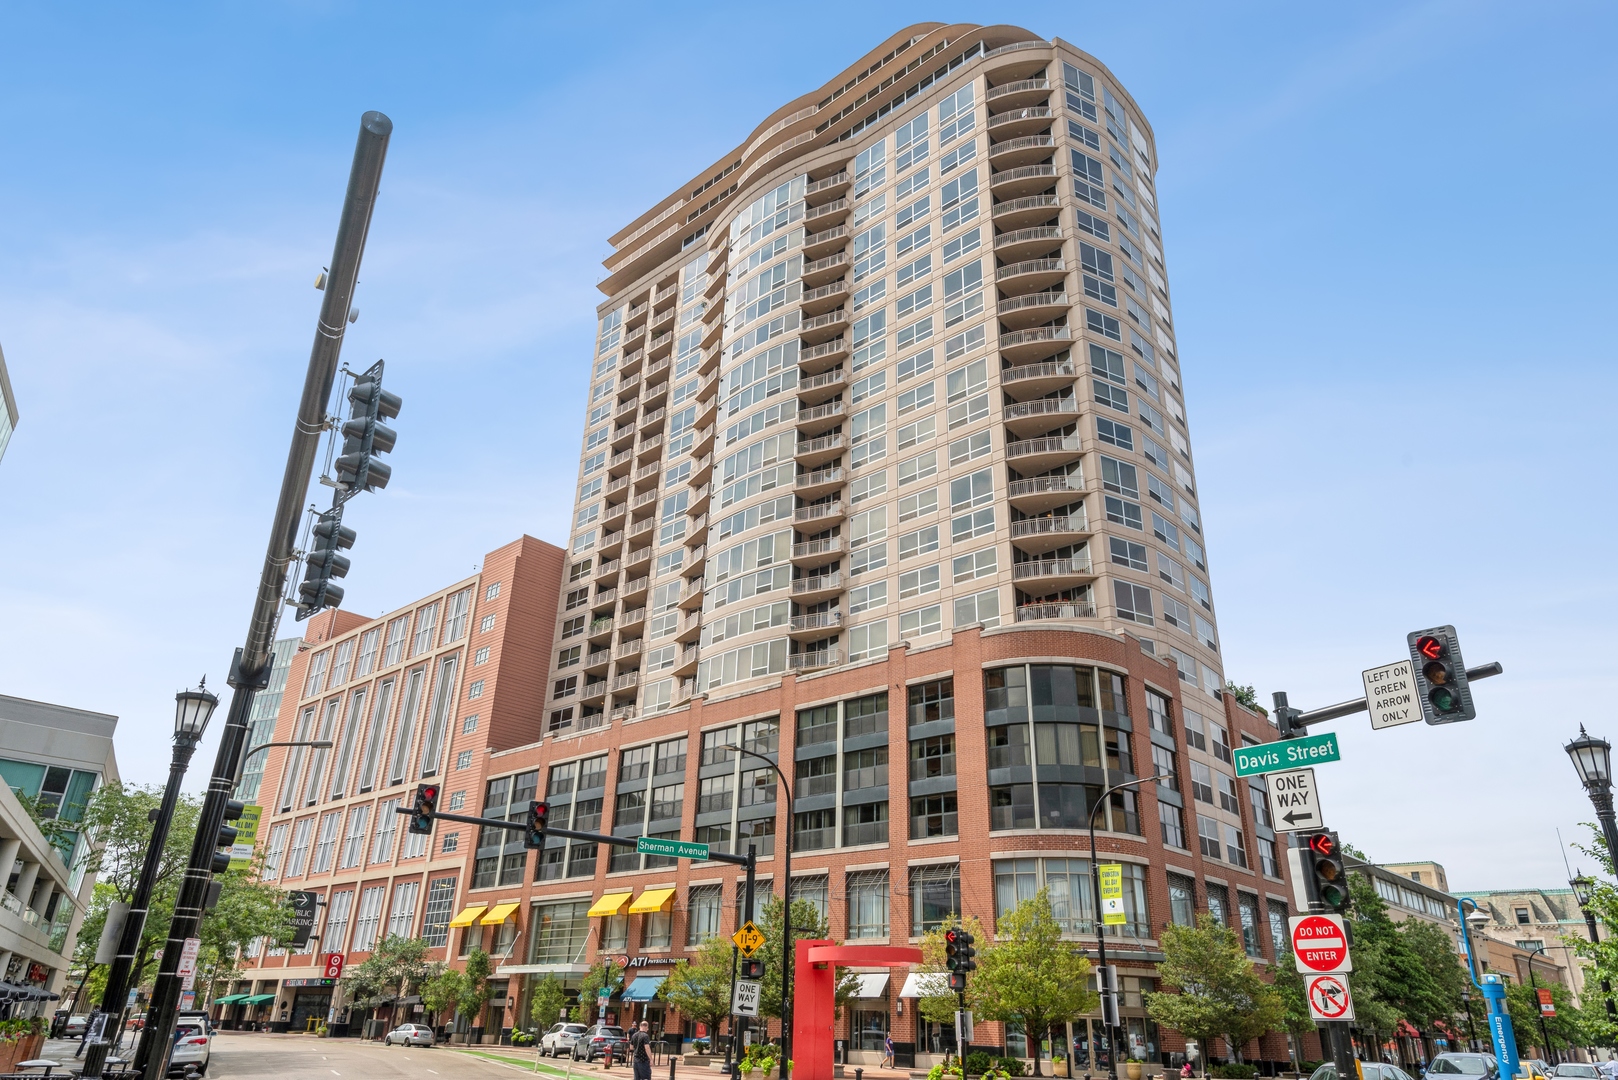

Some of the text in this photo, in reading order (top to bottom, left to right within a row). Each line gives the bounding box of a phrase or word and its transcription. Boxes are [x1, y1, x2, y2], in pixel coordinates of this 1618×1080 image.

[1367, 666, 1408, 683] LEFT ON
[1374, 681, 1407, 695] GREEN
[1376, 694, 1411, 710] ARROW
[1382, 708, 1409, 722] ONLY
[1239, 740, 1335, 769] Davis Street
[1275, 775, 1307, 791] ONE
[1277, 791, 1309, 807] WAY
[241, 813, 258, 821] ANSTON
[639, 841, 707, 856] Sherman Avenue
[288, 918, 313, 926] ARKING
[1300, 926, 1334, 936] DO NOT
[629, 957, 648, 966] ATI
[1306, 951, 1337, 961] ENTER
[740, 984, 756, 994] ONE
[738, 993, 756, 1002] WAY
[1495, 1016, 1509, 1064] Emergency
